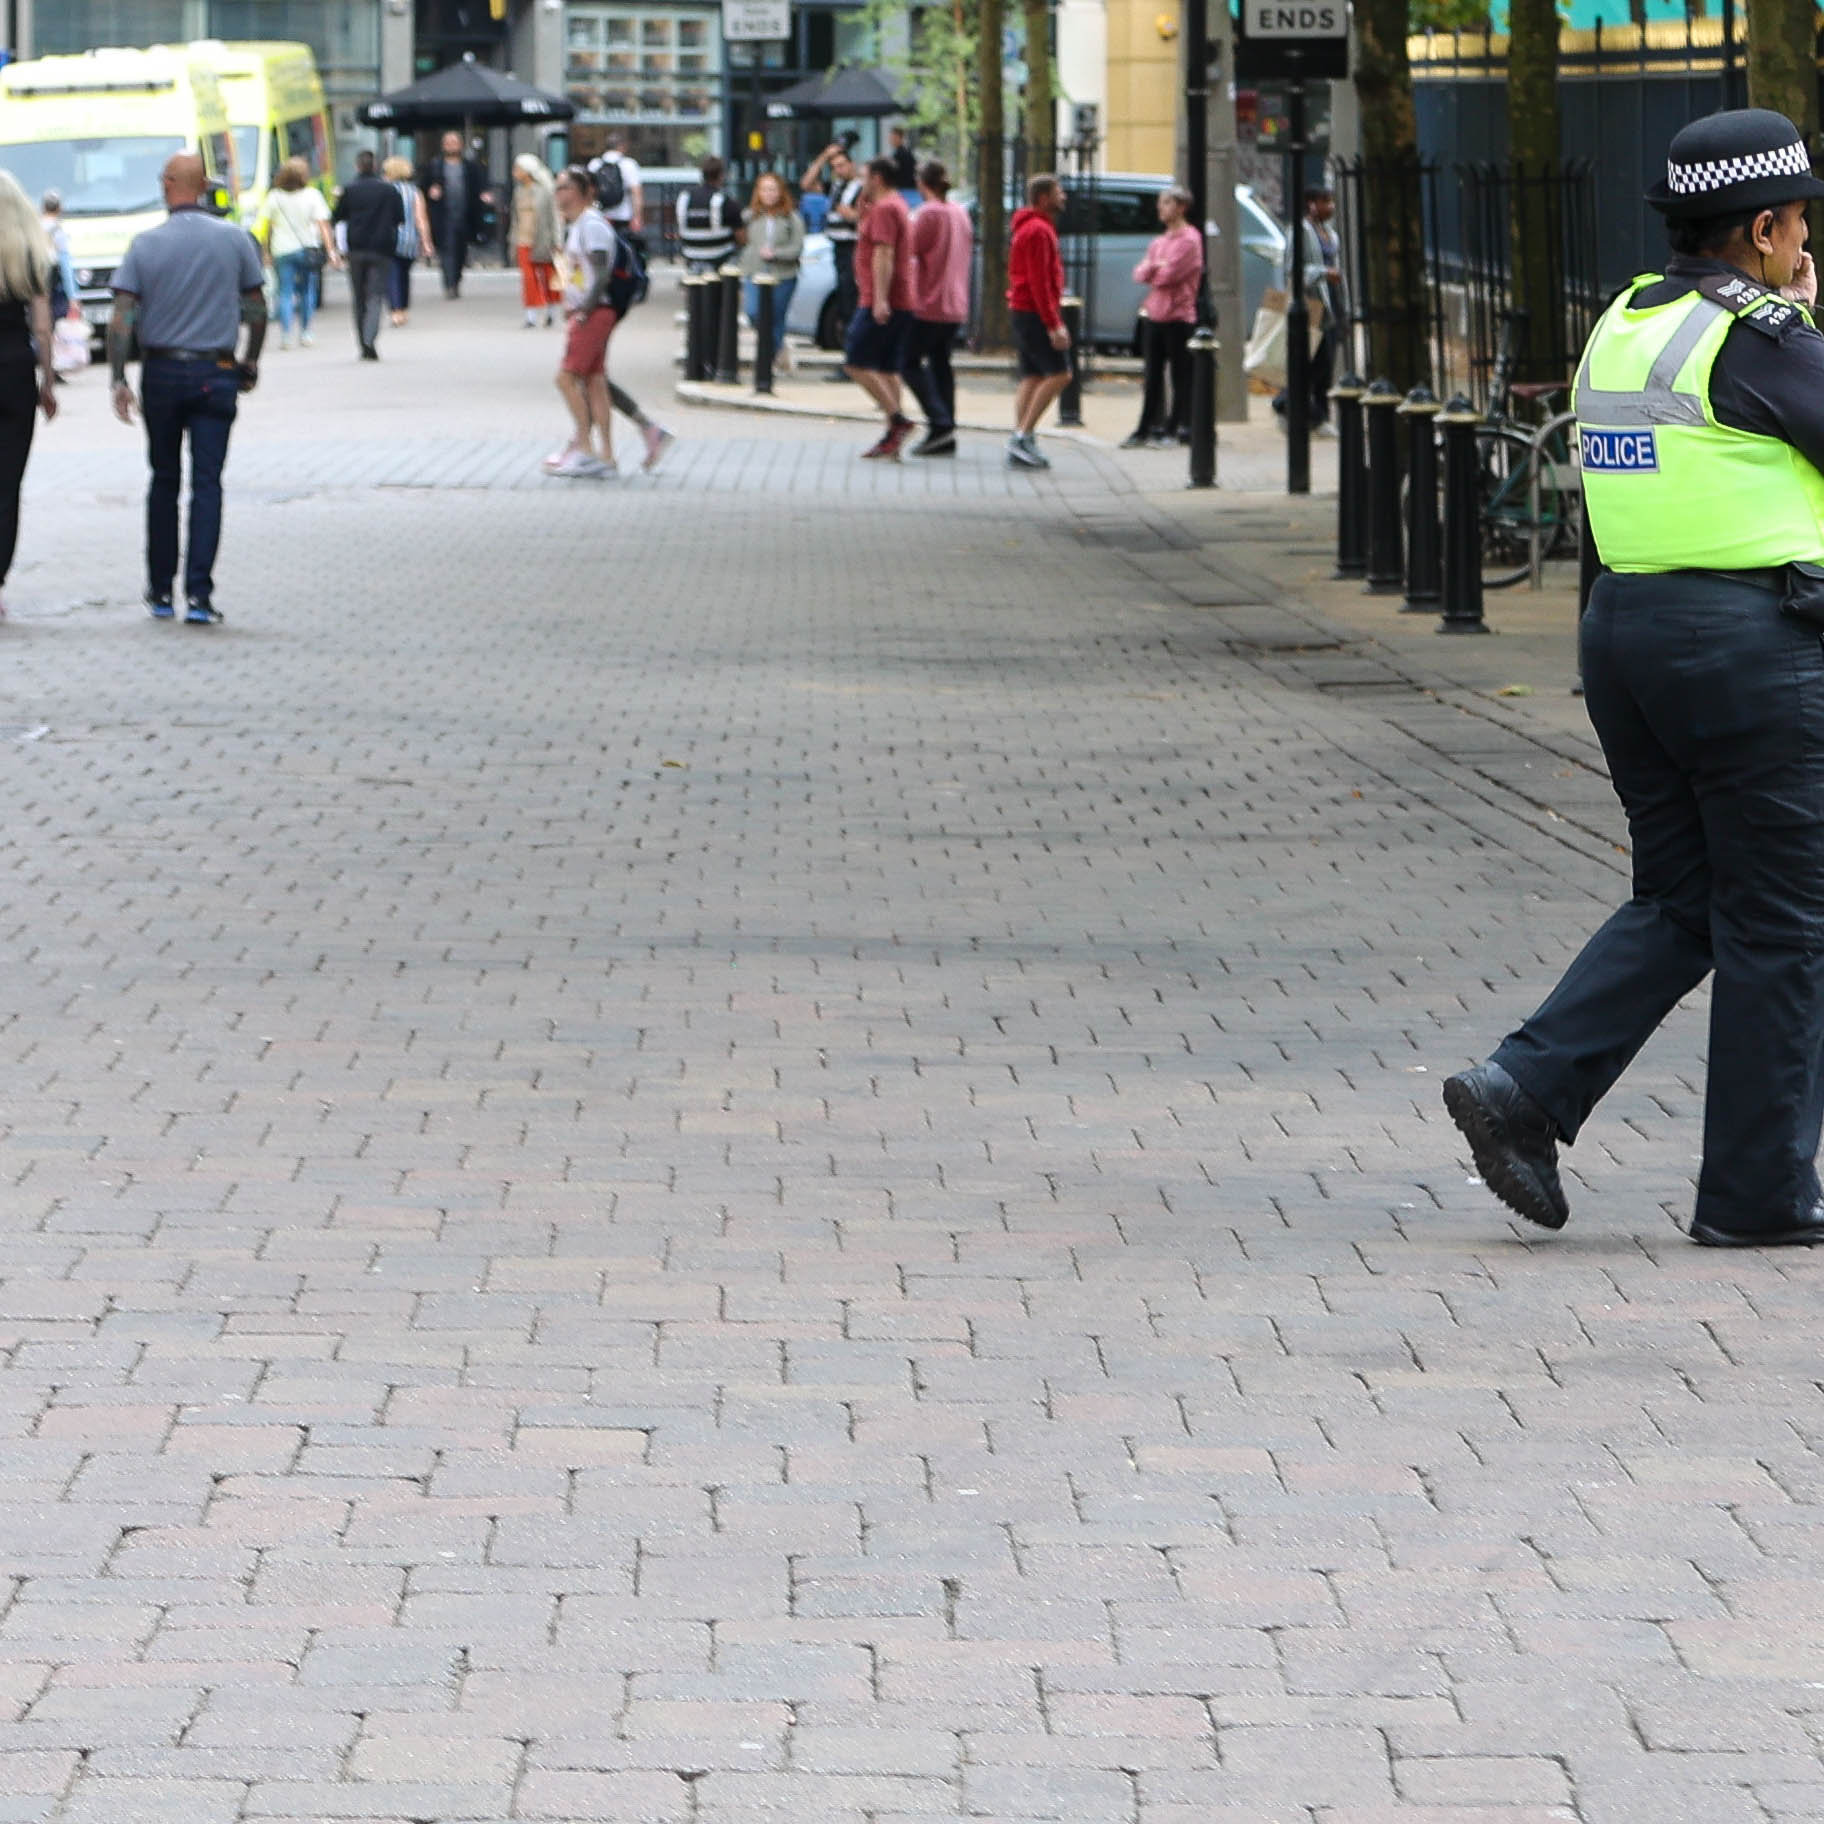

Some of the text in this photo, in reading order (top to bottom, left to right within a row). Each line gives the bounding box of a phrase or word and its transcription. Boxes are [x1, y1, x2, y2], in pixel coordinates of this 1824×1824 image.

[1259, 8, 1335, 29] ENDS
[1737, 287, 1761, 305] 133
[1768, 306, 1792, 326] 133
[1582, 434, 1654, 466] POLICE
